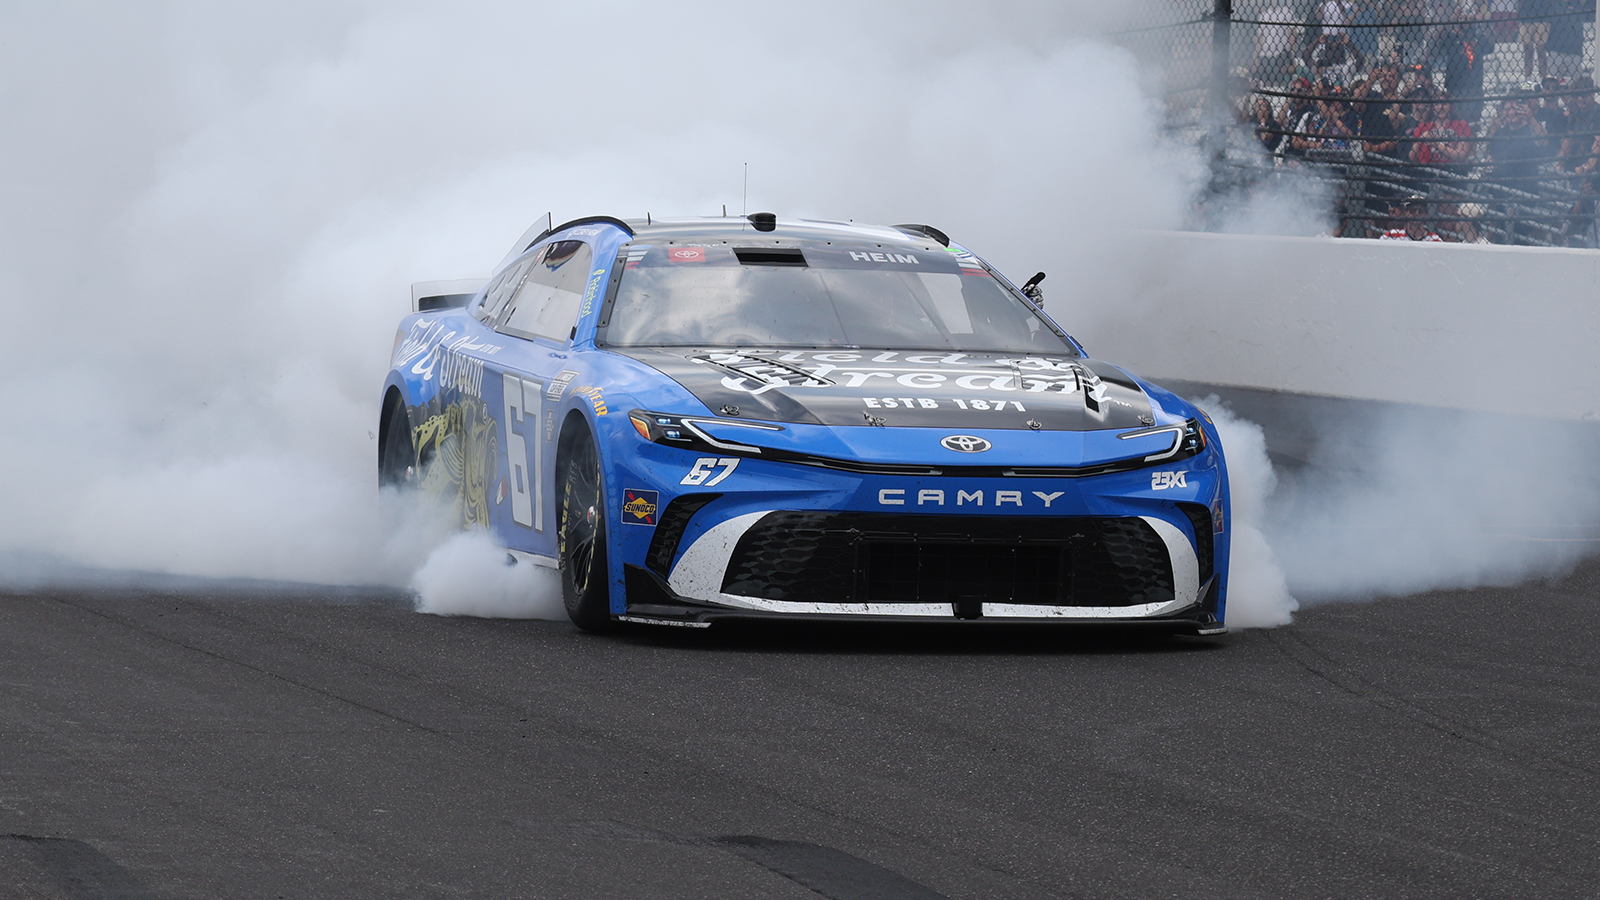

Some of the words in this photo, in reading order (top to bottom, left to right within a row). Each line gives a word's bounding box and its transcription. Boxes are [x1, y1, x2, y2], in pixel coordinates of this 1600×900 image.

[848, 251, 920, 265] HEIM
[581, 277, 601, 318] Robinhood
[862, 397, 940, 409] ESTB
[952, 399, 1027, 412] 1871
[503, 373, 543, 532] 67
[679, 457, 741, 487] 67
[624, 502, 656, 514] SUNOCO
[878, 489, 1065, 507] CAMRY
[560, 482, 571, 552] EAGLE
